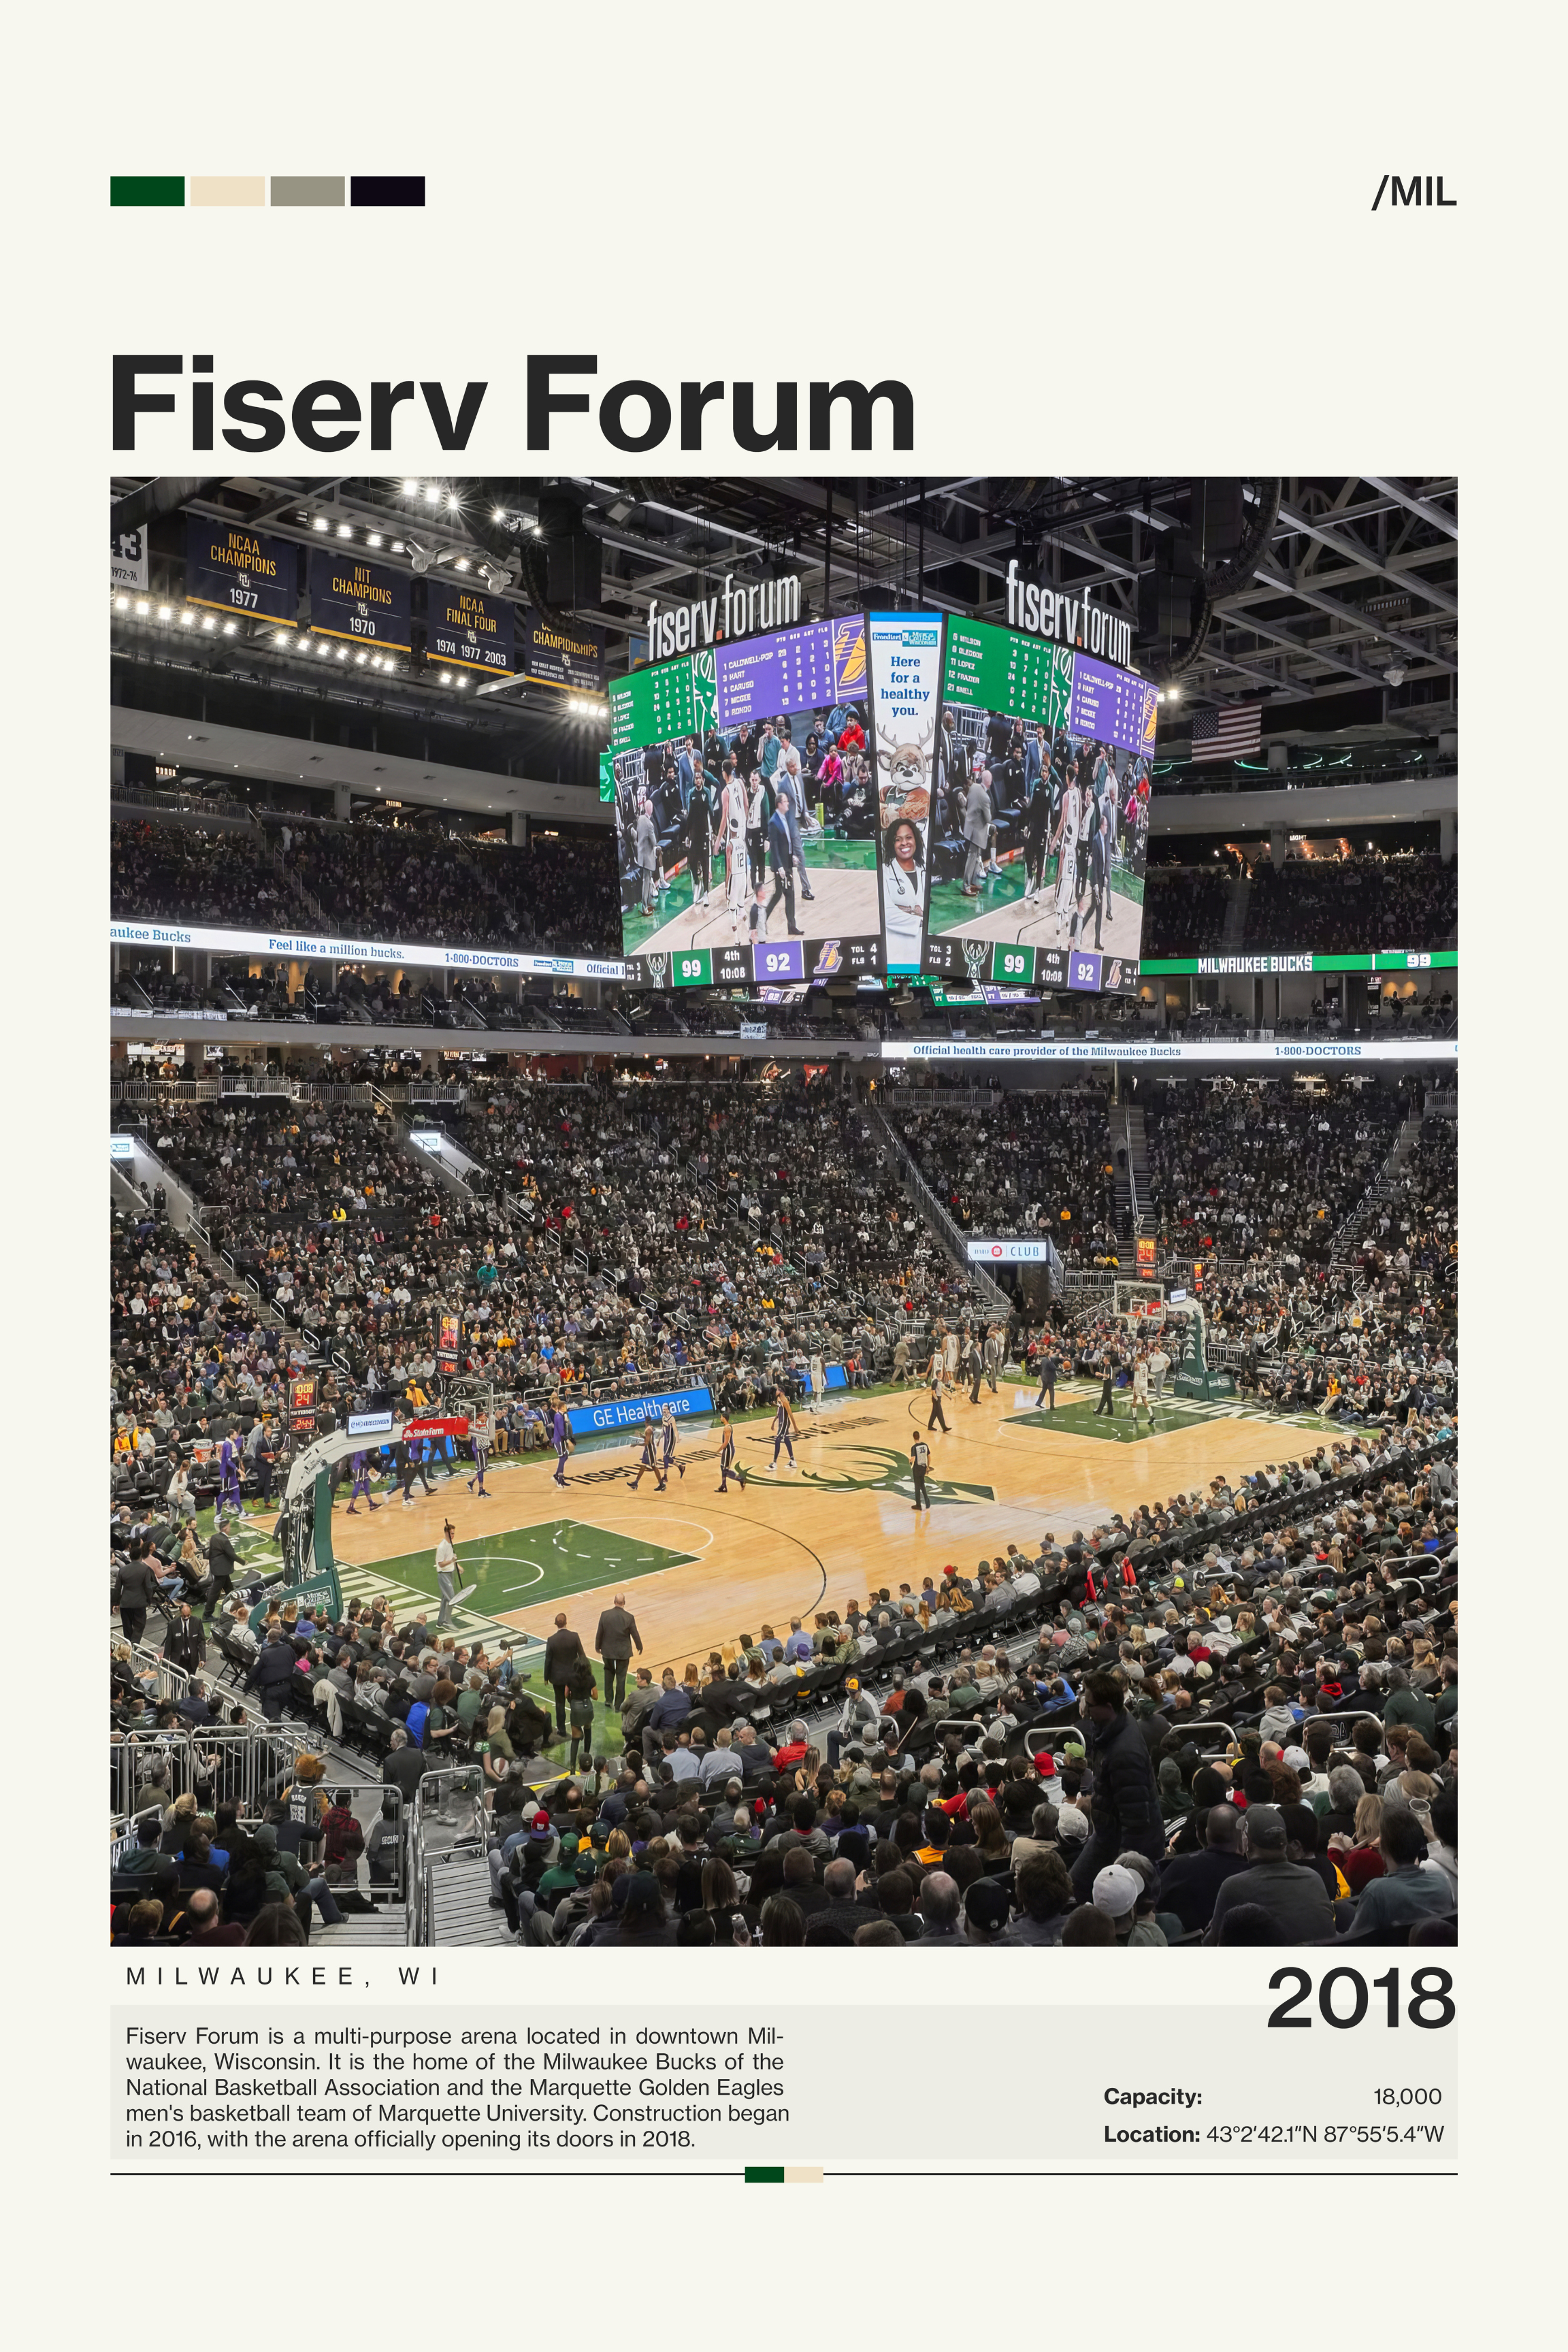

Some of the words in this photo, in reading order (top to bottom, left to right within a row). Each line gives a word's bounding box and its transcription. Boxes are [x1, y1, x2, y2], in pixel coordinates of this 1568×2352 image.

[229, 533, 260, 555] NCAA
[210, 545, 277, 576] CHAMPIONS
[355, 566, 371, 583] NIT
[230, 588, 259, 608] 1977
[332, 577, 392, 604] CHAMPIONS
[459, 595, 485, 614] NCAA
[349, 617, 375, 636] 1970
[446, 608, 472, 627] FINAL
[474, 615, 497, 633] FOUR
[436, 638, 455, 654] 1974
[461, 644, 480, 660] 1977
[485, 650, 506, 666] 2003
[533, 630, 598, 658] CHAMPIONSHIPS
[890, 656, 921, 667] Here
[890, 672, 910, 683] for
[912, 674, 920, 683] a
[881, 688, 930, 702] healthy
[892, 707, 919, 717] you.
[152, 930, 191, 943] Bucks
[269, 938, 293, 951] Feel
[295, 940, 316, 953] like
[329, 943, 368, 956] million
[370, 946, 405, 959] bucks.
[724, 950, 740, 961] 4th
[870, 943, 877, 953] 4
[946, 945, 951, 954] 3
[444, 953, 519, 968] 1-800-DOCTORS
[586, 963, 619, 975] Official
[766, 953, 791, 972] 92
[870, 955, 877, 965] 1
[945, 957, 951, 966] 2
[1004, 954, 1025, 973] 99
[1046, 953, 1060, 964] 4th
[1198, 957, 1268, 974] MILWAUKEE
[1270, 956, 1313, 973] BUCKS
[1407, 953, 1431, 967] 99
[681, 960, 702, 977] 99
[720, 966, 746, 979] 10:08
[1077, 963, 1094, 981] 92
[913, 1045, 951, 1056] Official
[953, 1046, 987, 1056] health
[1013, 1046, 1056, 1056] provider
[1059, 1045, 1071, 1056] of
[1072, 1046, 1088, 1056] the
[1091, 1046, 1147, 1056] Milwaukee
[1149, 1047, 1181, 1056] Bucks
[1275, 1046, 1362, 1056] 1-800-DOCTORS
[1011, 1246, 1039, 1256] CLUB
[296, 1394, 310, 1406] 24
[593, 1408, 615, 1426] GE
